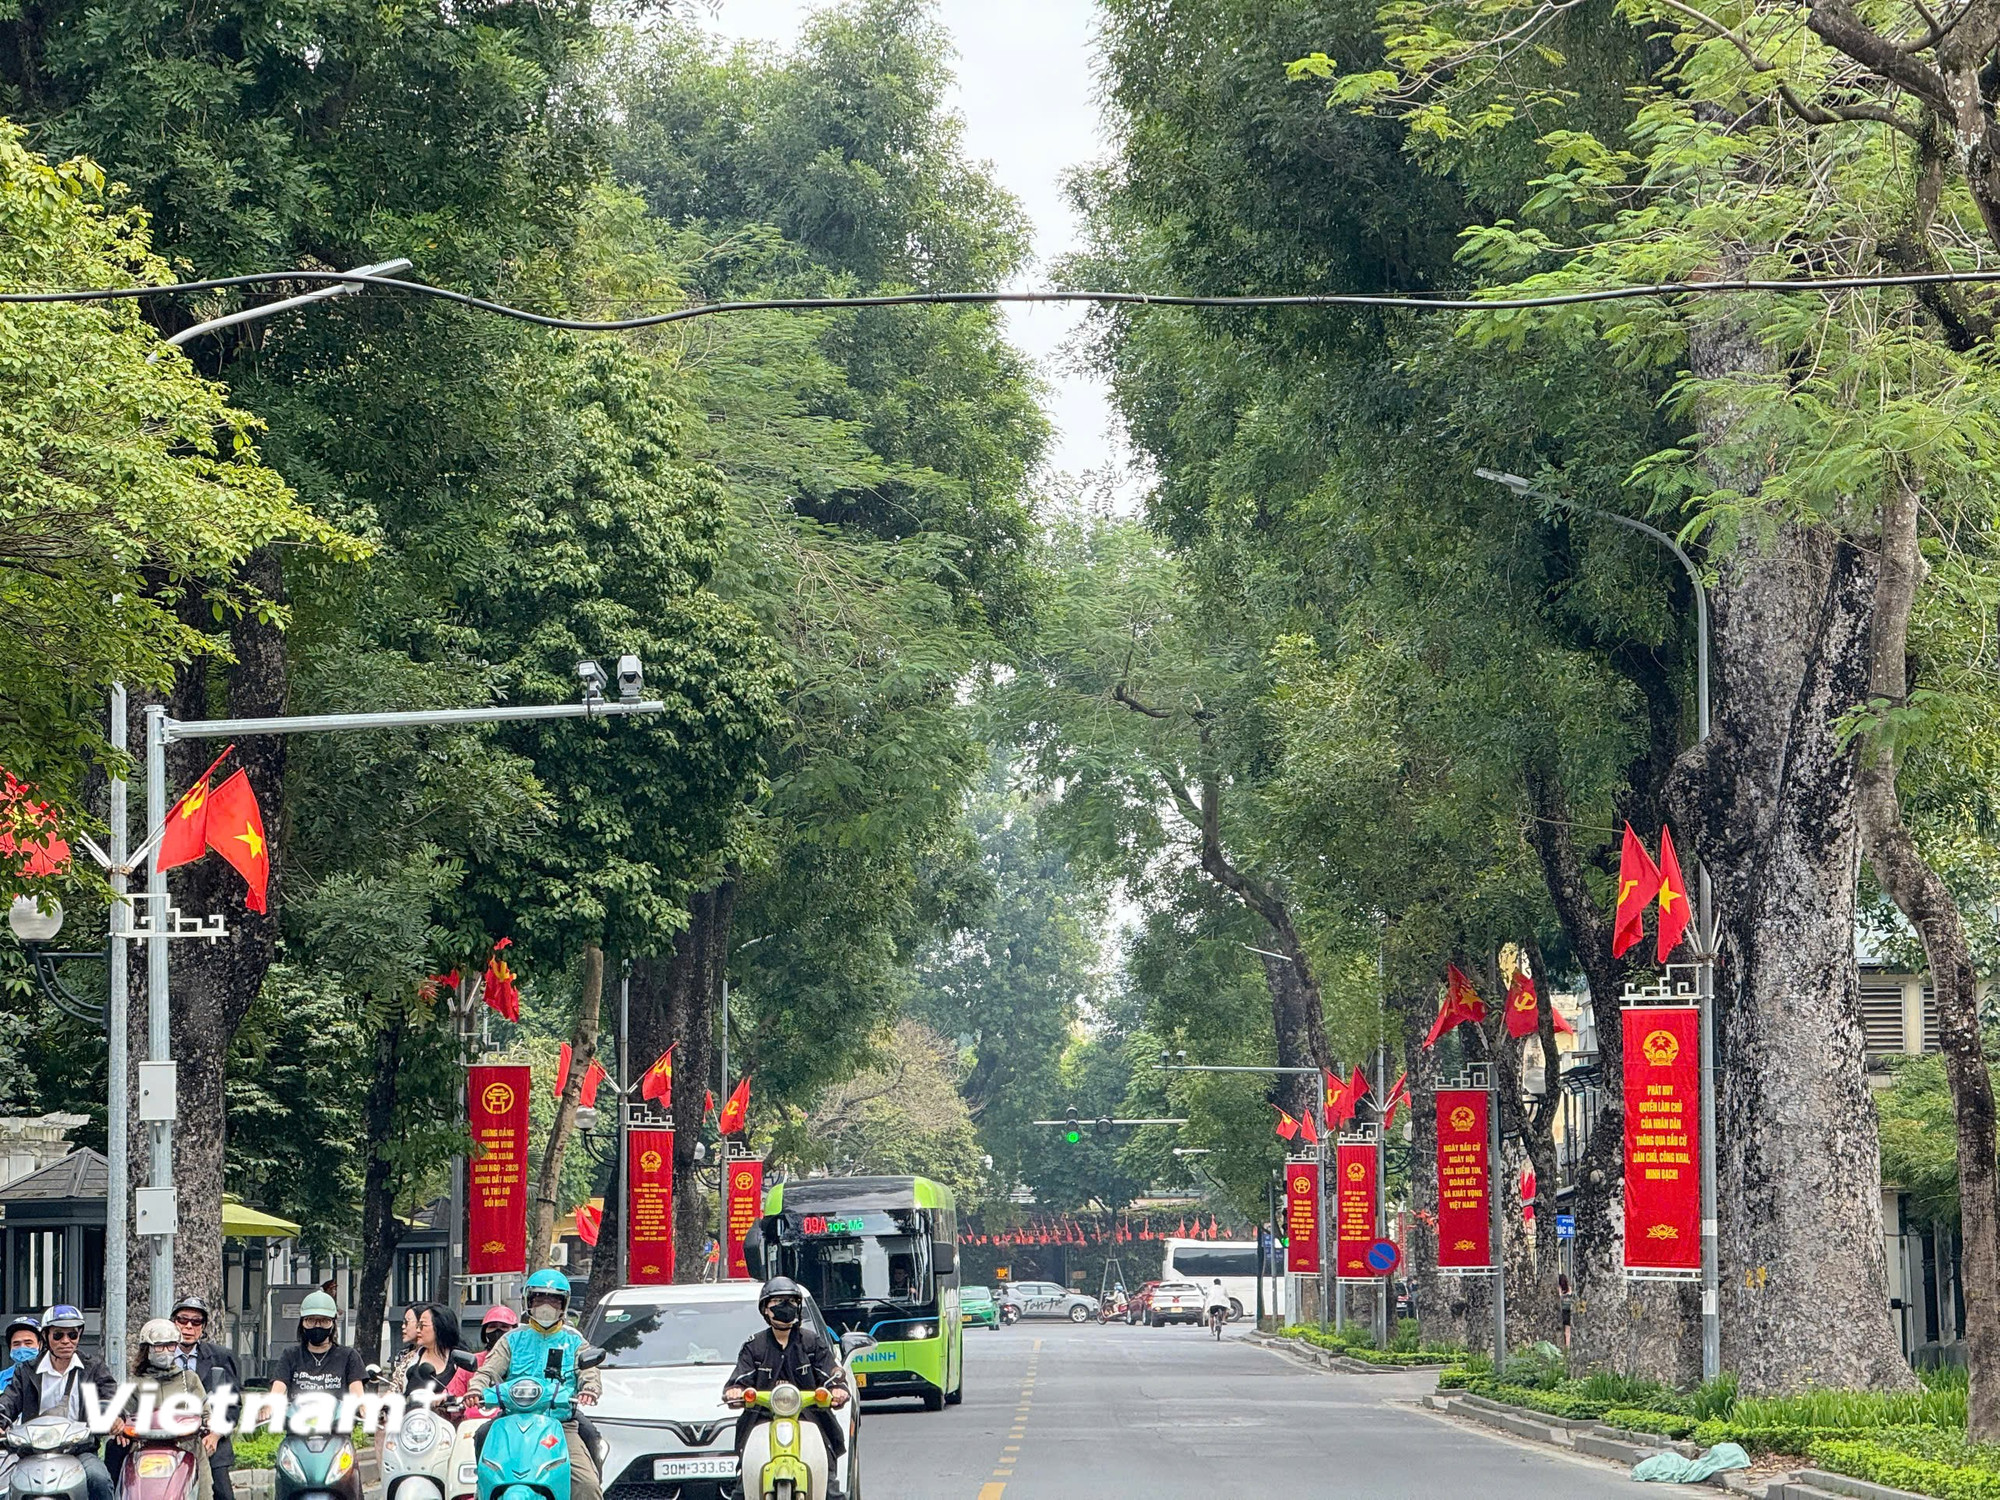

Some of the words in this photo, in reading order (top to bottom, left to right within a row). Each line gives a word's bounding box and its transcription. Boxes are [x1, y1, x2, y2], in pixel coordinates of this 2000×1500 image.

[1647, 1084, 1661, 1096] PHÁT
[1662, 1085, 1673, 1096] HUY
[1639, 1099, 1658, 1113] QUYỀN
[1658, 1100, 1670, 1112] LÀM
[1671, 1099, 1682, 1112] CHỦ
[1641, 1116, 1653, 1129] CỦA
[1653, 1117, 1669, 1129] NHÂN
[1670, 1117, 1681, 1129] DÂN
[1636, 1134, 1654, 1146] THÔNG
[1655, 1135, 1666, 1147] QUA
[1667, 1133, 1678, 1146] BẦU
[1679, 1133, 1687, 1146] CỬ
[1444, 1144, 1458, 1152] NGÀY
[1460, 1142, 1471, 1151] BẦU
[1449, 1155, 1464, 1163] NGÀY
[1466, 1154, 1475, 1164] HỘI
[1633, 1151, 1645, 1162] DÂN
[1646, 1149, 1659, 1163] CHỦ,
[1659, 1151, 1674, 1162] CÔNG
[1675, 1153, 1690, 1164] KHAI,
[1443, 1166, 1454, 1175] CỦA
[1455, 1165, 1470, 1174] NIỀM
[1646, 1169, 1660, 1179] MINH
[1449, 1177, 1464, 1186] ĐOÀN
[1466, 1176, 1476, 1185] KẾT
[1452, 1189, 1466, 1197] KHÁT
[1467, 1190, 1482, 1198] VỌNG
[1449, 1201, 1461, 1210] VIỆT
[804, 1216, 827, 1234] 09A
[866, 1352, 896, 1362] NINH
